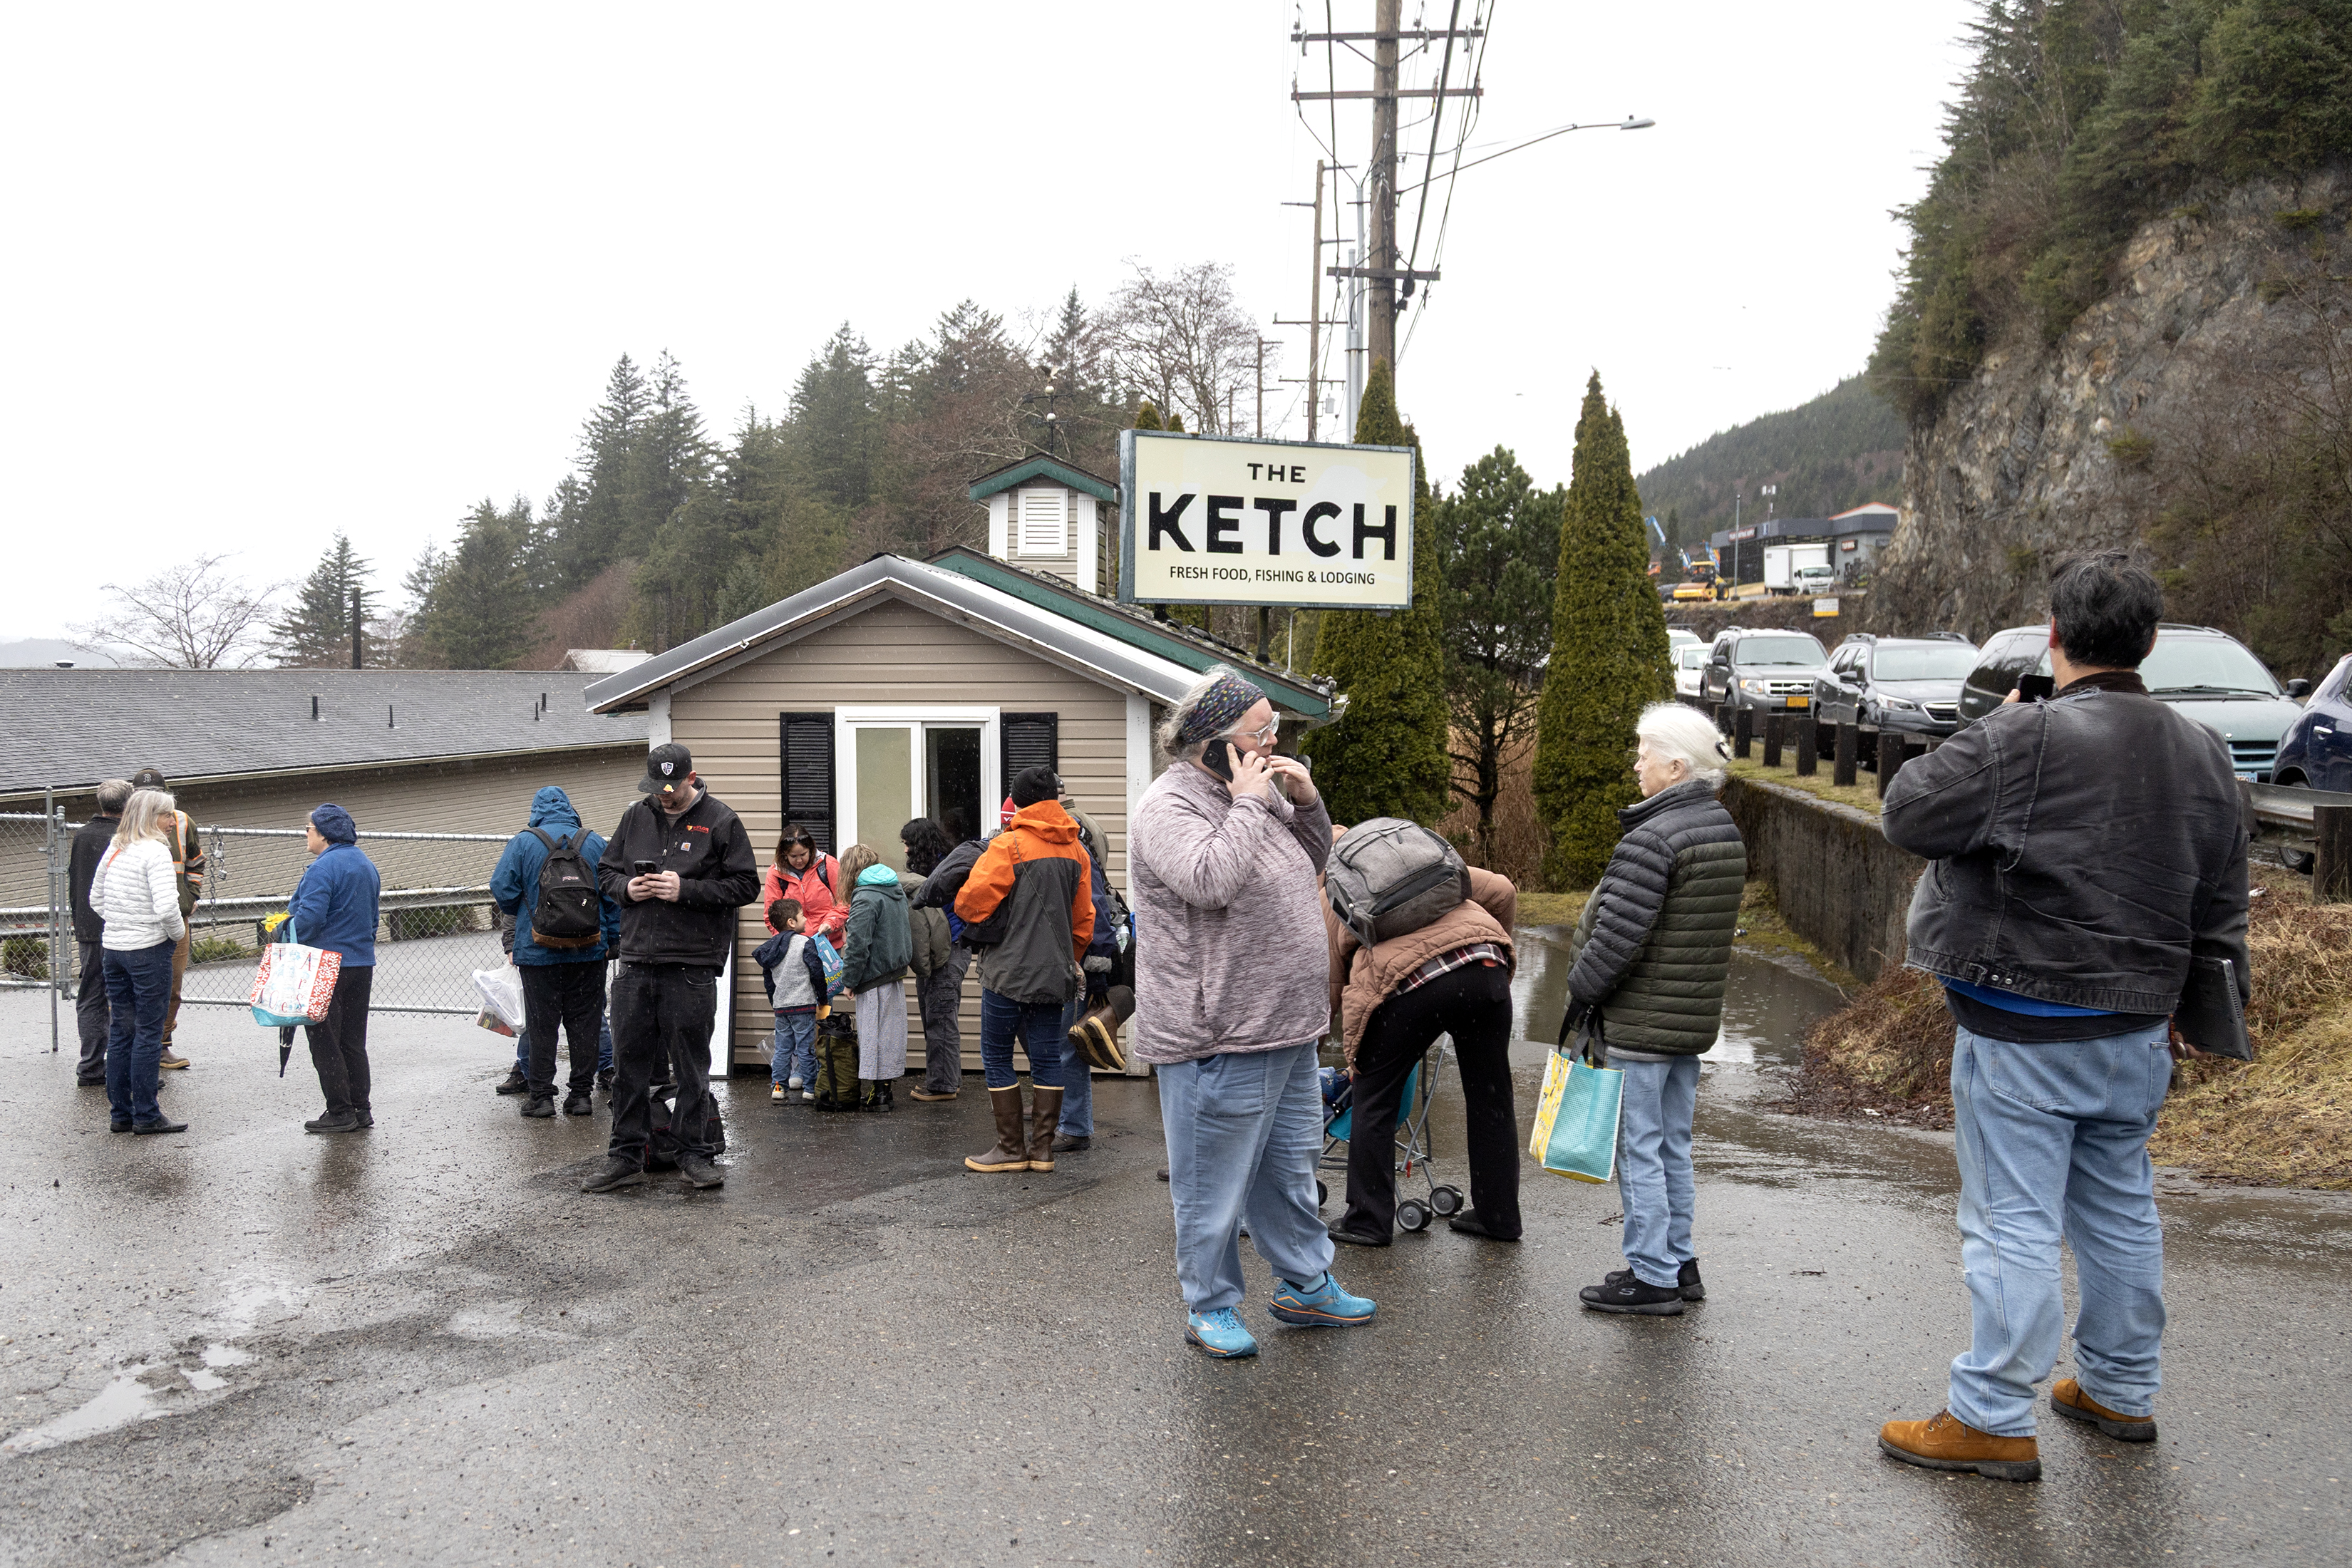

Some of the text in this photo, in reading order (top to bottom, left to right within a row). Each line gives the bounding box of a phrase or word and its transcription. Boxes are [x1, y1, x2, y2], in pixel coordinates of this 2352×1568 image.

[1247, 463, 1306, 483] THE
[1148, 491, 1397, 561] KETCH
[1170, 566, 1376, 585] FRESH FOOD, FISHING & LODGING
[826, 981, 841, 995] ou'll
